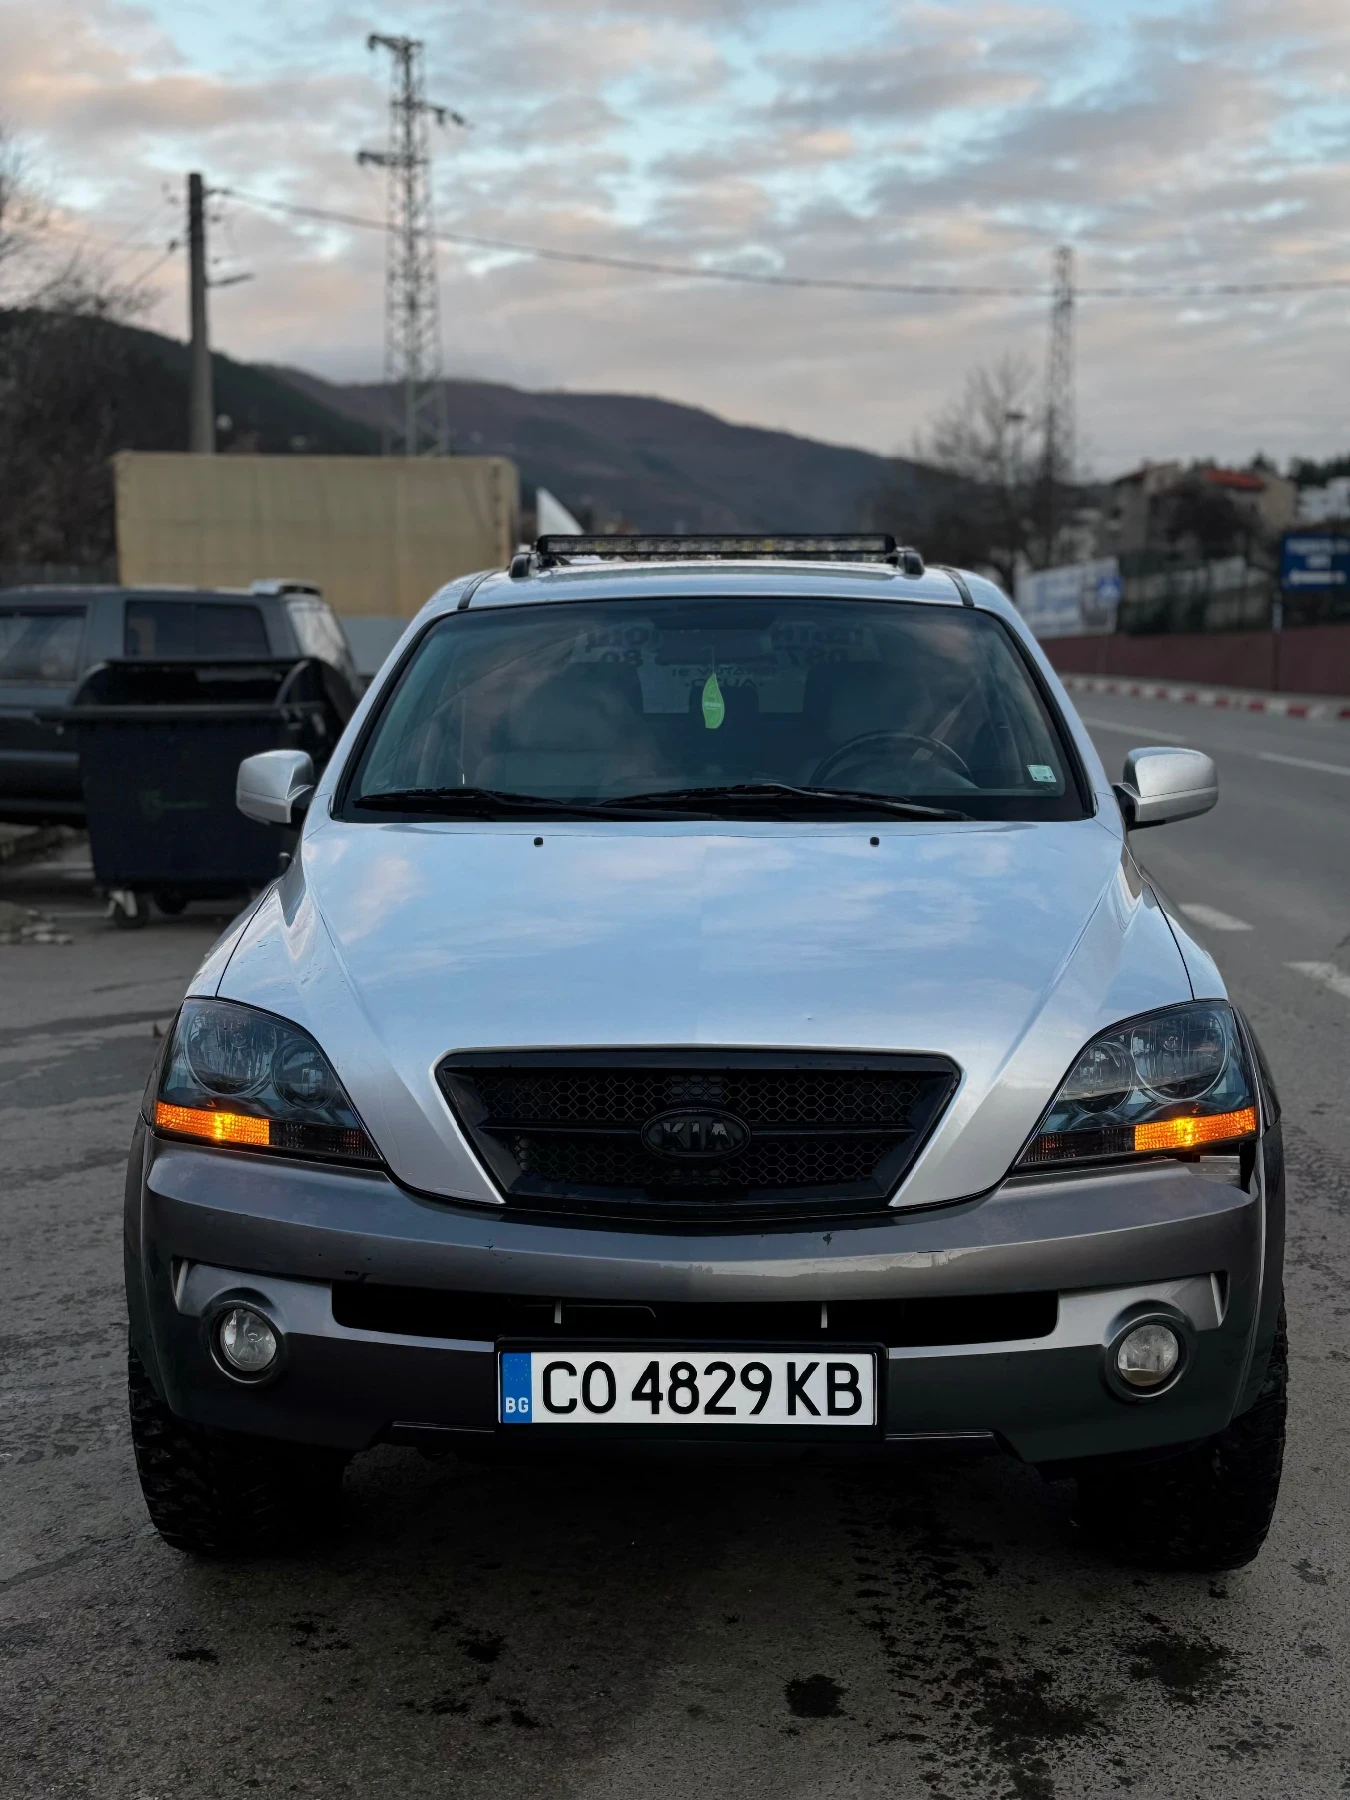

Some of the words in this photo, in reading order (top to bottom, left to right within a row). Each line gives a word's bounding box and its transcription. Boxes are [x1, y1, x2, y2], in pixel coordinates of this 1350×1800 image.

[661, 1122, 736, 1150] KIA
[542, 1360, 617, 1414] CO
[631, 1360, 773, 1416] 4829
[786, 1361, 863, 1417] KB
[505, 1396, 529, 1413] BG
